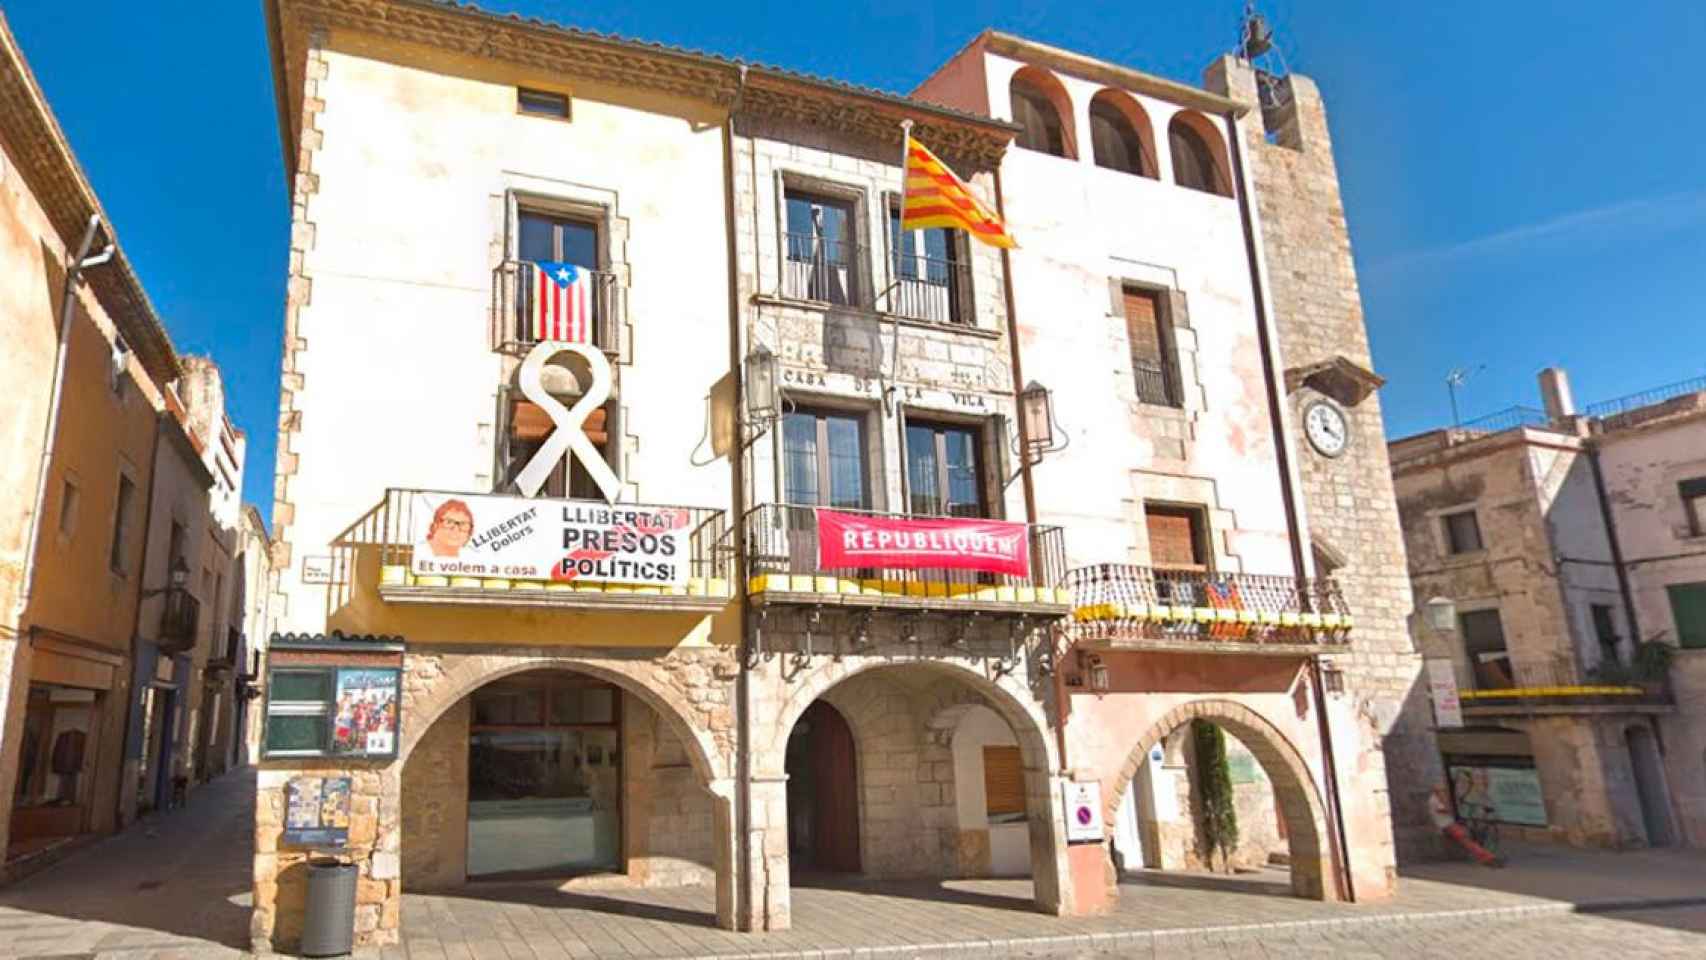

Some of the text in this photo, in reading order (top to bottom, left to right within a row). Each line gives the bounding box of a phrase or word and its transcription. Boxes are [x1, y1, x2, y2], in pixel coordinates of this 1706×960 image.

[784, 369, 985, 407] CASA DE LA VILA
[472, 507, 538, 548] LLIBERTAT
[562, 506, 675, 529] LLIBERTAT
[490, 525, 534, 552] Dolors
[562, 528, 676, 556] PRESOS
[419, 560, 537, 576] Et volem a casa
[562, 556, 676, 581] POLÍTICS!
